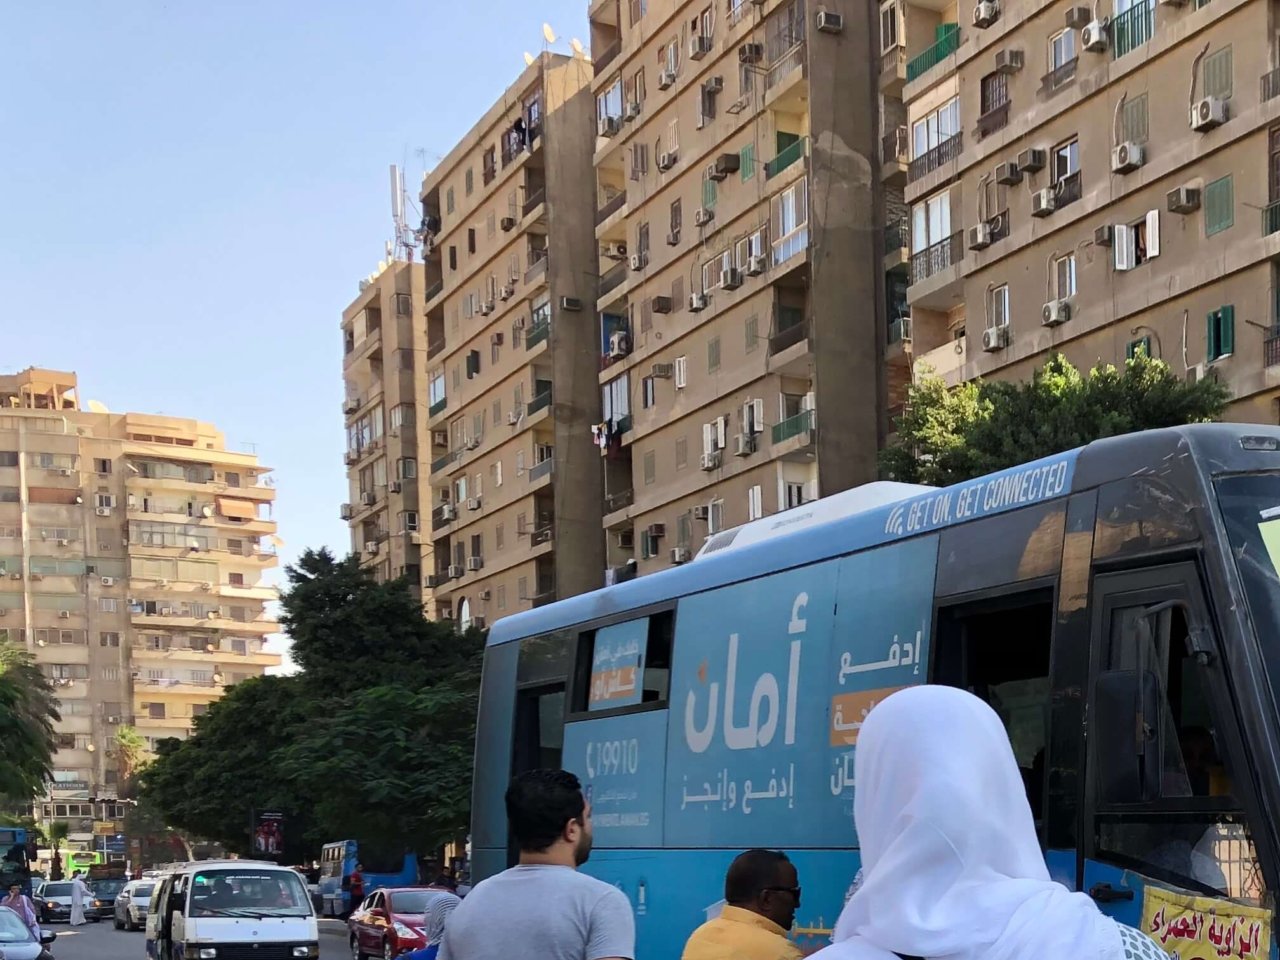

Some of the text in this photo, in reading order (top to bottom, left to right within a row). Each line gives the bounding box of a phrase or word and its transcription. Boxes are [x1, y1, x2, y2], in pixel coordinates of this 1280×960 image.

[906, 498, 934, 532] GET
[955, 484, 984, 518] GET
[983, 461, 1068, 511] CONNECTED
[838, 631, 922, 685] إدفع
[597, 739, 638, 776] 19910
[1151, 905, 1204, 944] الحمراء
[1207, 906, 1262, 960] الزاوية
